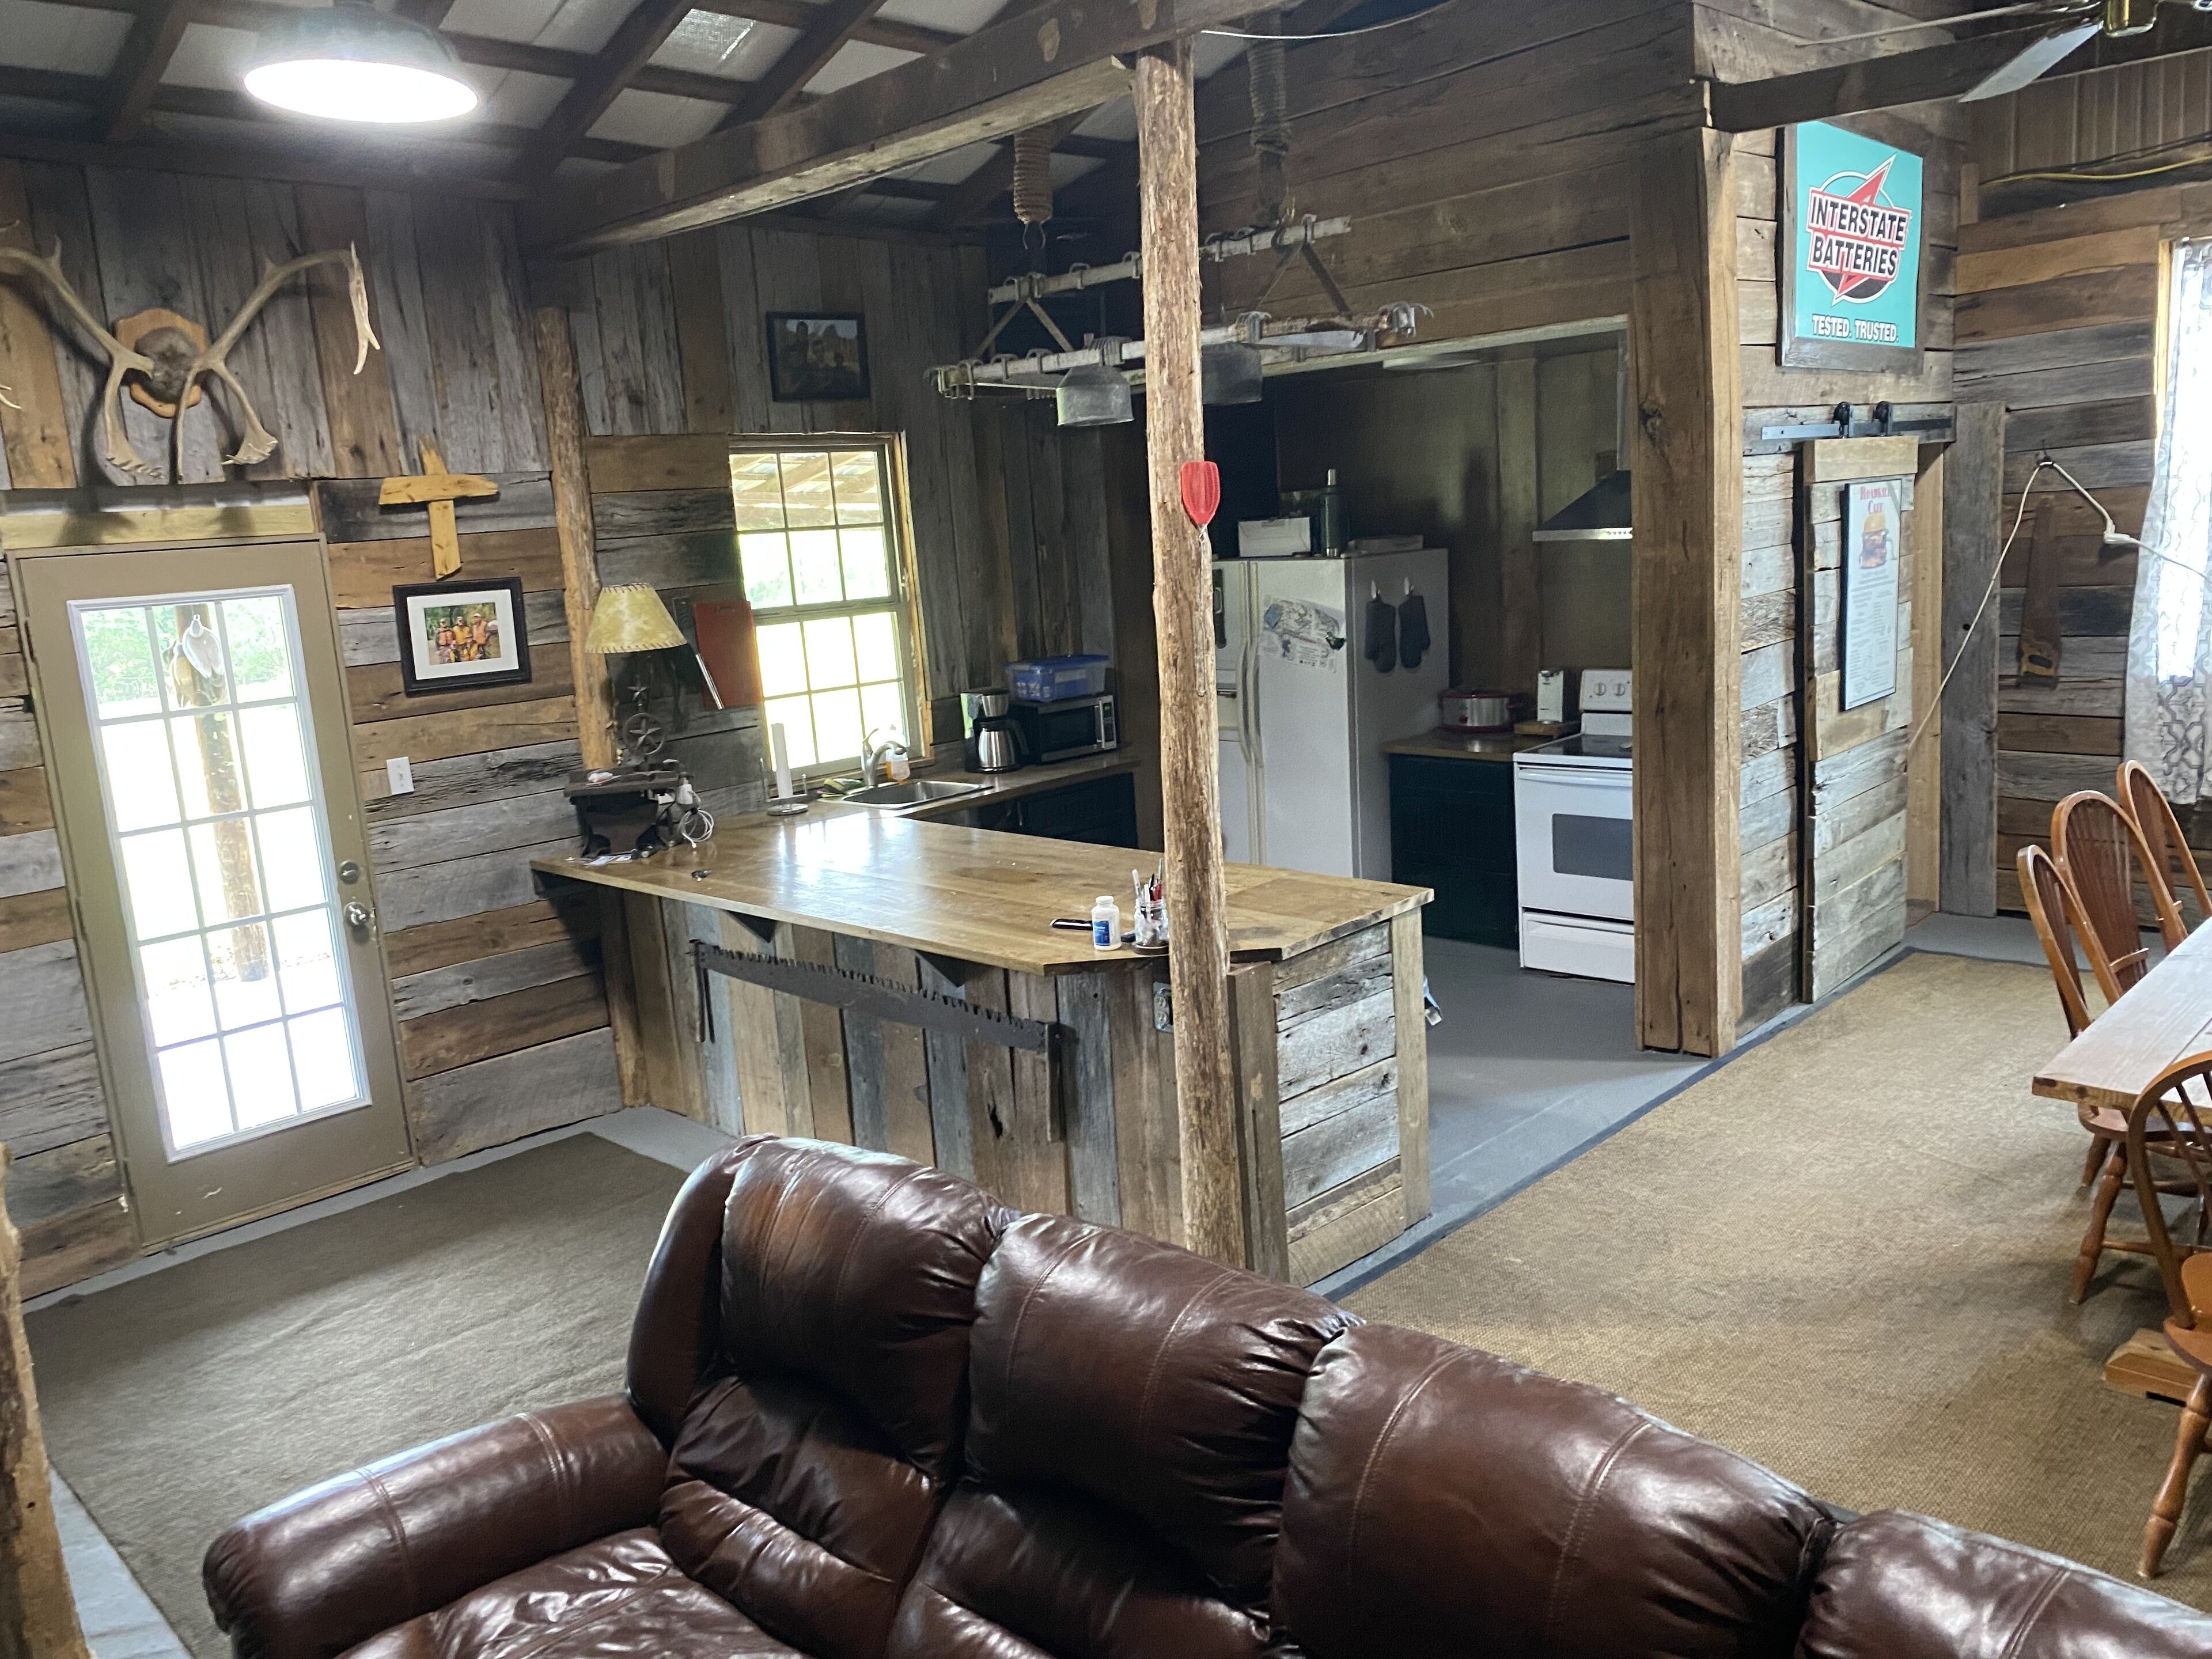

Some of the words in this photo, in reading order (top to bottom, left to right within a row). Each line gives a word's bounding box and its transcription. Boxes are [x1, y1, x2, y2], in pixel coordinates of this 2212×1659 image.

[1810, 195, 1908, 243] INTERSTATE
[1812, 234, 1899, 276] BATTERIES
[1812, 315, 1851, 338] TESTED.
[1855, 320, 1899, 342] TRUSTED.
